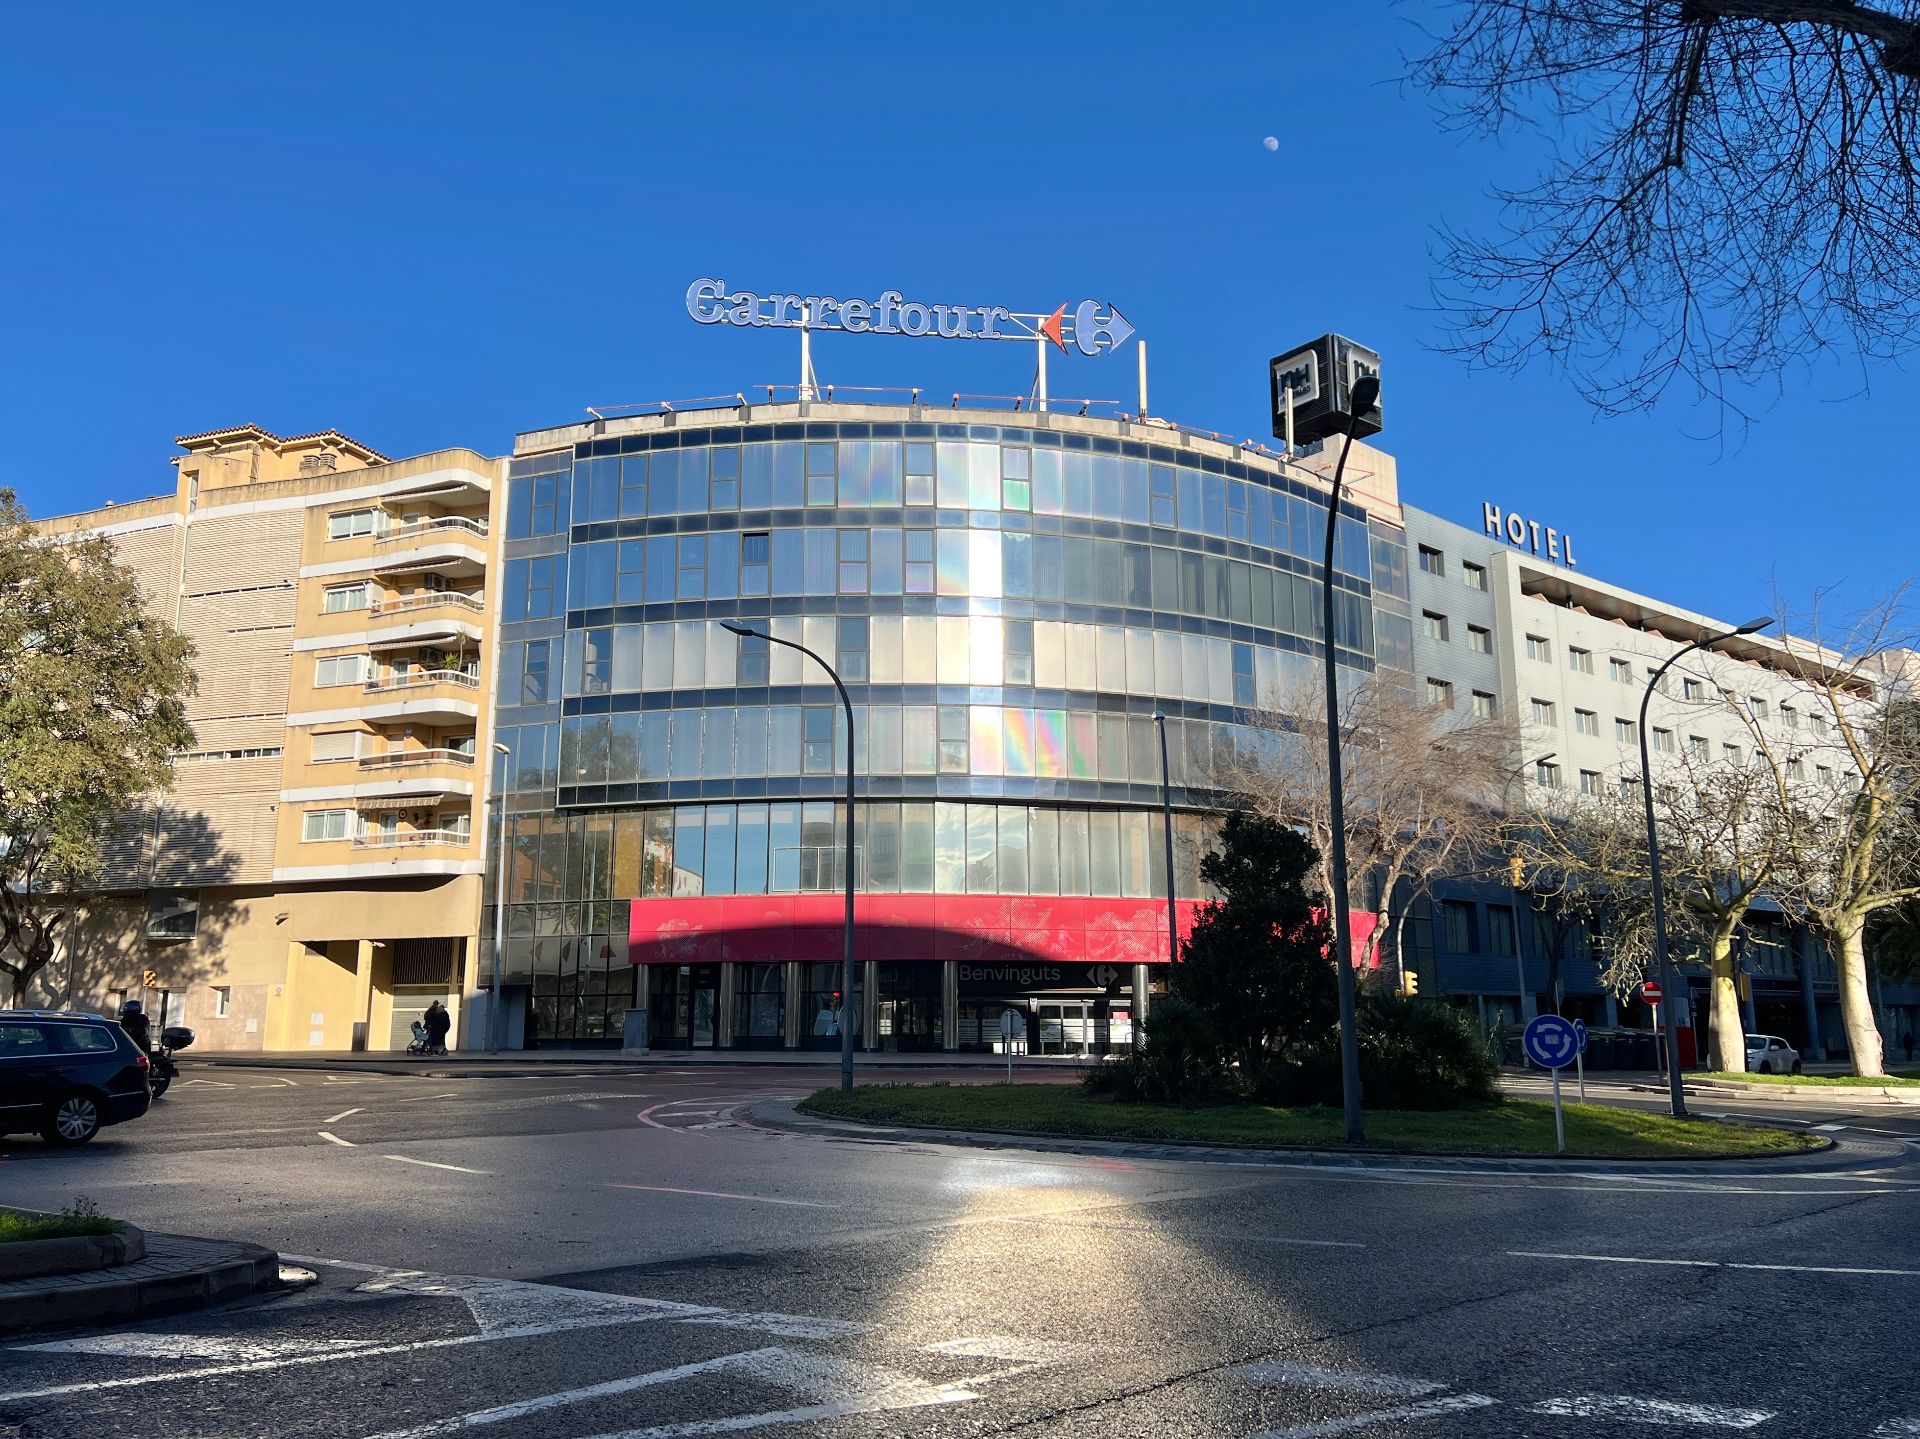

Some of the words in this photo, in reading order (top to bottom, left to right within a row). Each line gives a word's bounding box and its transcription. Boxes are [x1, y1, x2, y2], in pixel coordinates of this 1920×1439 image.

[686, 277, 1009, 340] Carrefour
[1482, 502, 1576, 565] HOTEL
[959, 964, 1061, 985] Benvinguts
